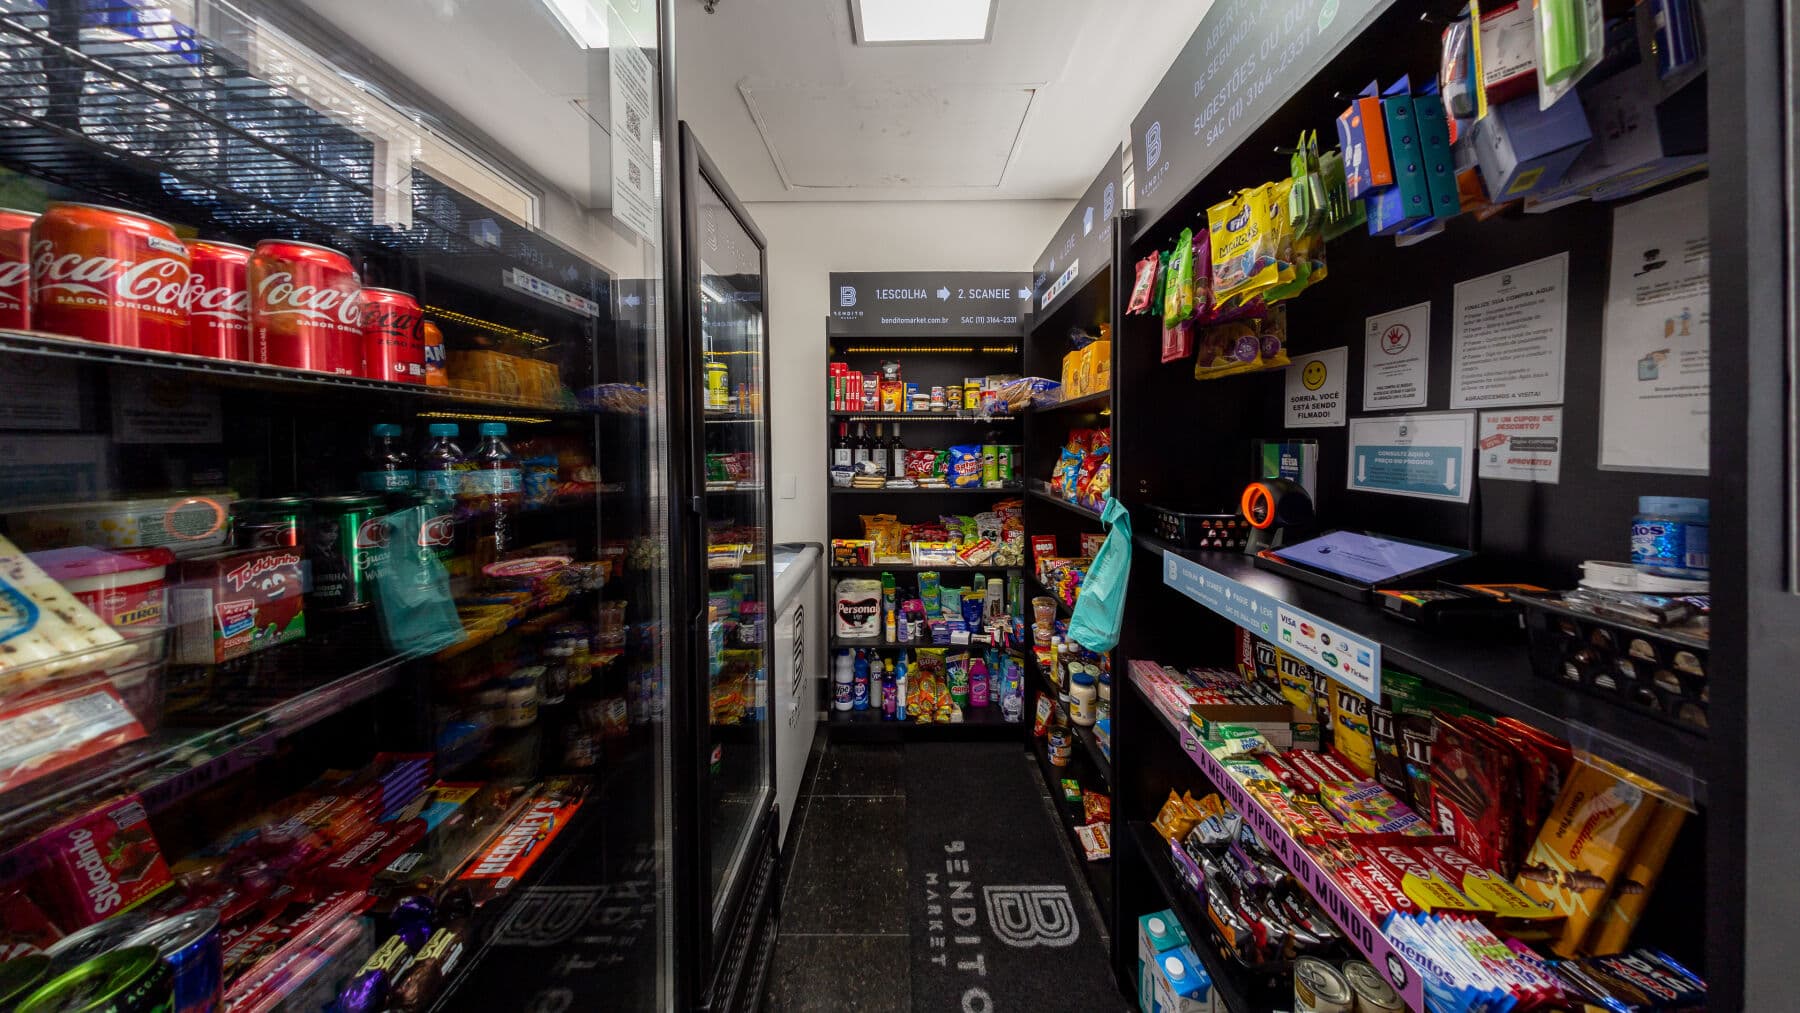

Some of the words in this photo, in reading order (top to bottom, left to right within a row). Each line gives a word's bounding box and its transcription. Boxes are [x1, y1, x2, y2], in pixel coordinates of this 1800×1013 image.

[1207, 10, 1257, 81] SEGUNDA
[1193, 53, 1256, 136] SUGESTÕES
[1206, 117, 1225, 147] SAC
[1228, 98, 1243, 128] (11)
[1246, 25, 1311, 106] 3164-2331
[57, 296, 108, 306] SABOR
[115, 300, 179, 316] ORIGINAL
[875, 289, 928, 300] 1.ESCOLHA
[958, 288, 966, 300] 2.
[969, 288, 1011, 300] SCANEIE
[296, 319, 334, 329] SABOR
[881, 316, 949, 325] benditomarket.com.br
[961, 316, 974, 324] SAC
[975, 316, 985, 325] (11)
[986, 316, 1017, 324] 3164-2331
[1293, 403, 1310, 411] ESTÁ
[1311, 401, 1337, 410] SENDO
[1319, 391, 1340, 400] VOCÊ
[1297, 411, 1330, 419] FILMADO!
[226, 553, 301, 592] Toddynho
[837, 603, 879, 614] Personal
[1280, 613, 1297, 628] VISA
[1208, 760, 1245, 811] MELHOR
[1247, 801, 1290, 860] PIPOCA
[1292, 851, 1310, 884] DO
[1315, 872, 1375, 955] MUNDO
[1342, 871, 1391, 915] TRENTO
[1363, 864, 1412, 908] TRENTO
[925, 872, 947, 967] MARKET
[1390, 935, 1456, 986] mentos
